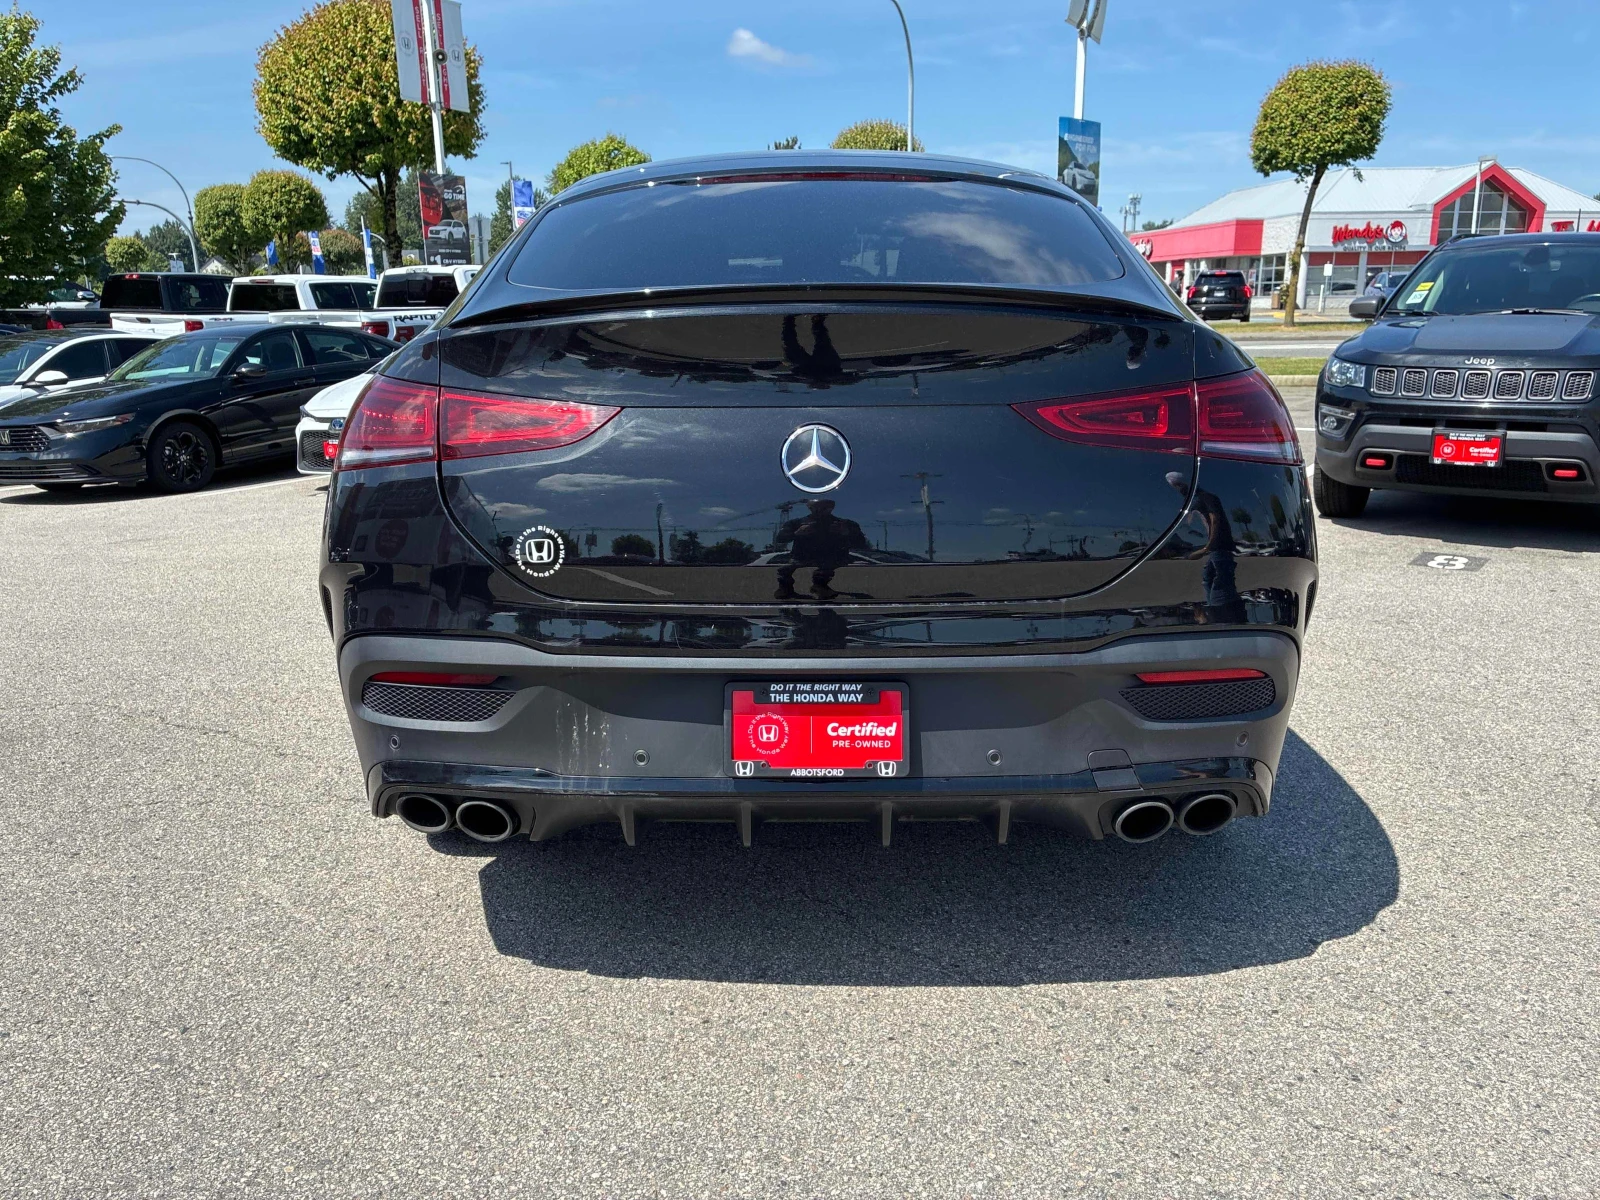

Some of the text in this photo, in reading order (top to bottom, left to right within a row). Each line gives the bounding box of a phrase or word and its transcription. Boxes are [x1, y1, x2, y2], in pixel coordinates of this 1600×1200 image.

[1332, 220, 1384, 244] Wendy's
[1465, 356, 1495, 366] Jeep
[523, 526, 536, 536] the
[537, 525, 559, 538] Right
[1427, 555, 1469, 570] 8
[526, 568, 555, 577] Honda
[770, 693, 863, 702] THE HONDA WAY
[755, 713, 766, 721] the
[767, 712, 784, 722] Right
[827, 722, 897, 737] Certified
[832, 740, 891, 748] PRE-OWNED
[756, 747, 780, 755] Honda
[790, 768, 844, 777] ABBOTSFORD
